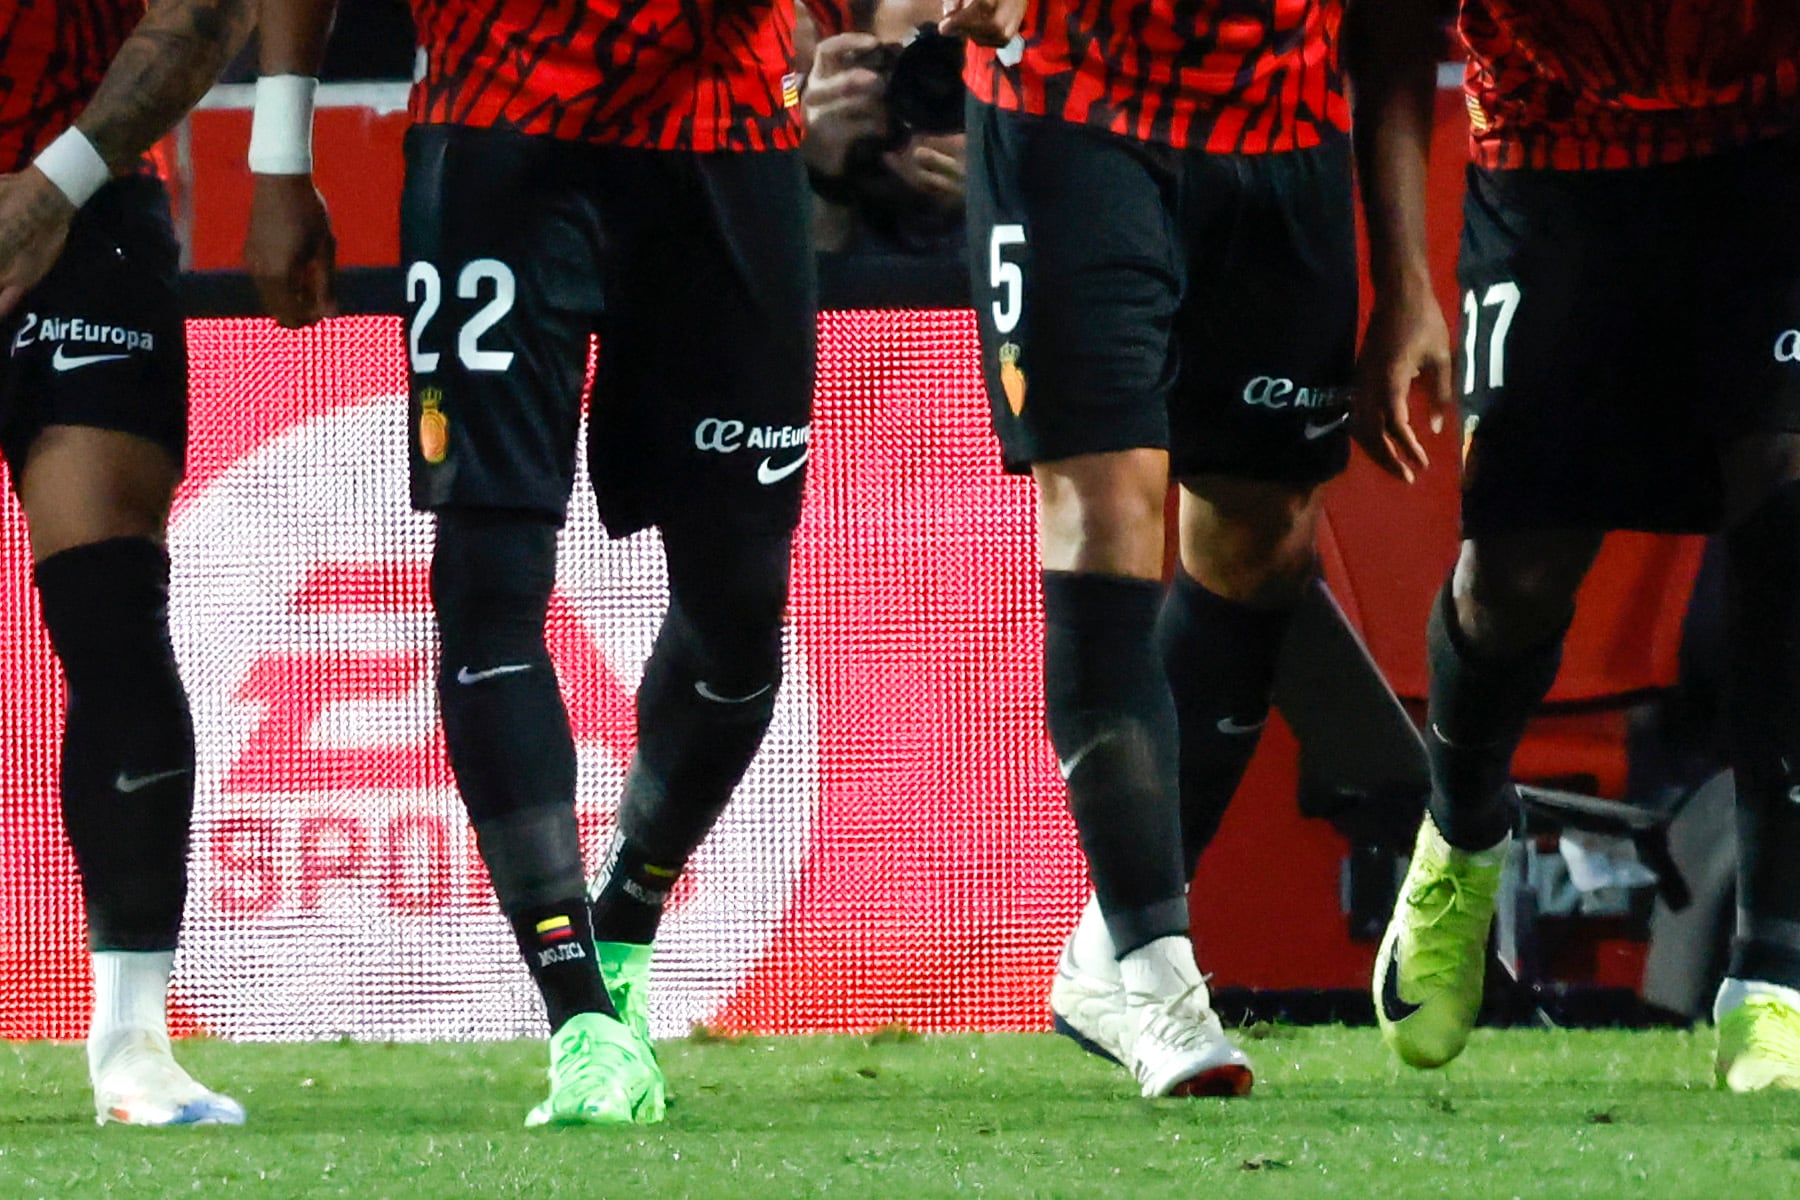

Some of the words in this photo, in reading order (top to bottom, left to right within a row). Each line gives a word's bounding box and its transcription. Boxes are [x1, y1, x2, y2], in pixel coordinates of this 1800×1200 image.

[407, 258, 517, 374] 22
[990, 224, 1027, 333] 5
[39, 317, 154, 351] AirEuropa
